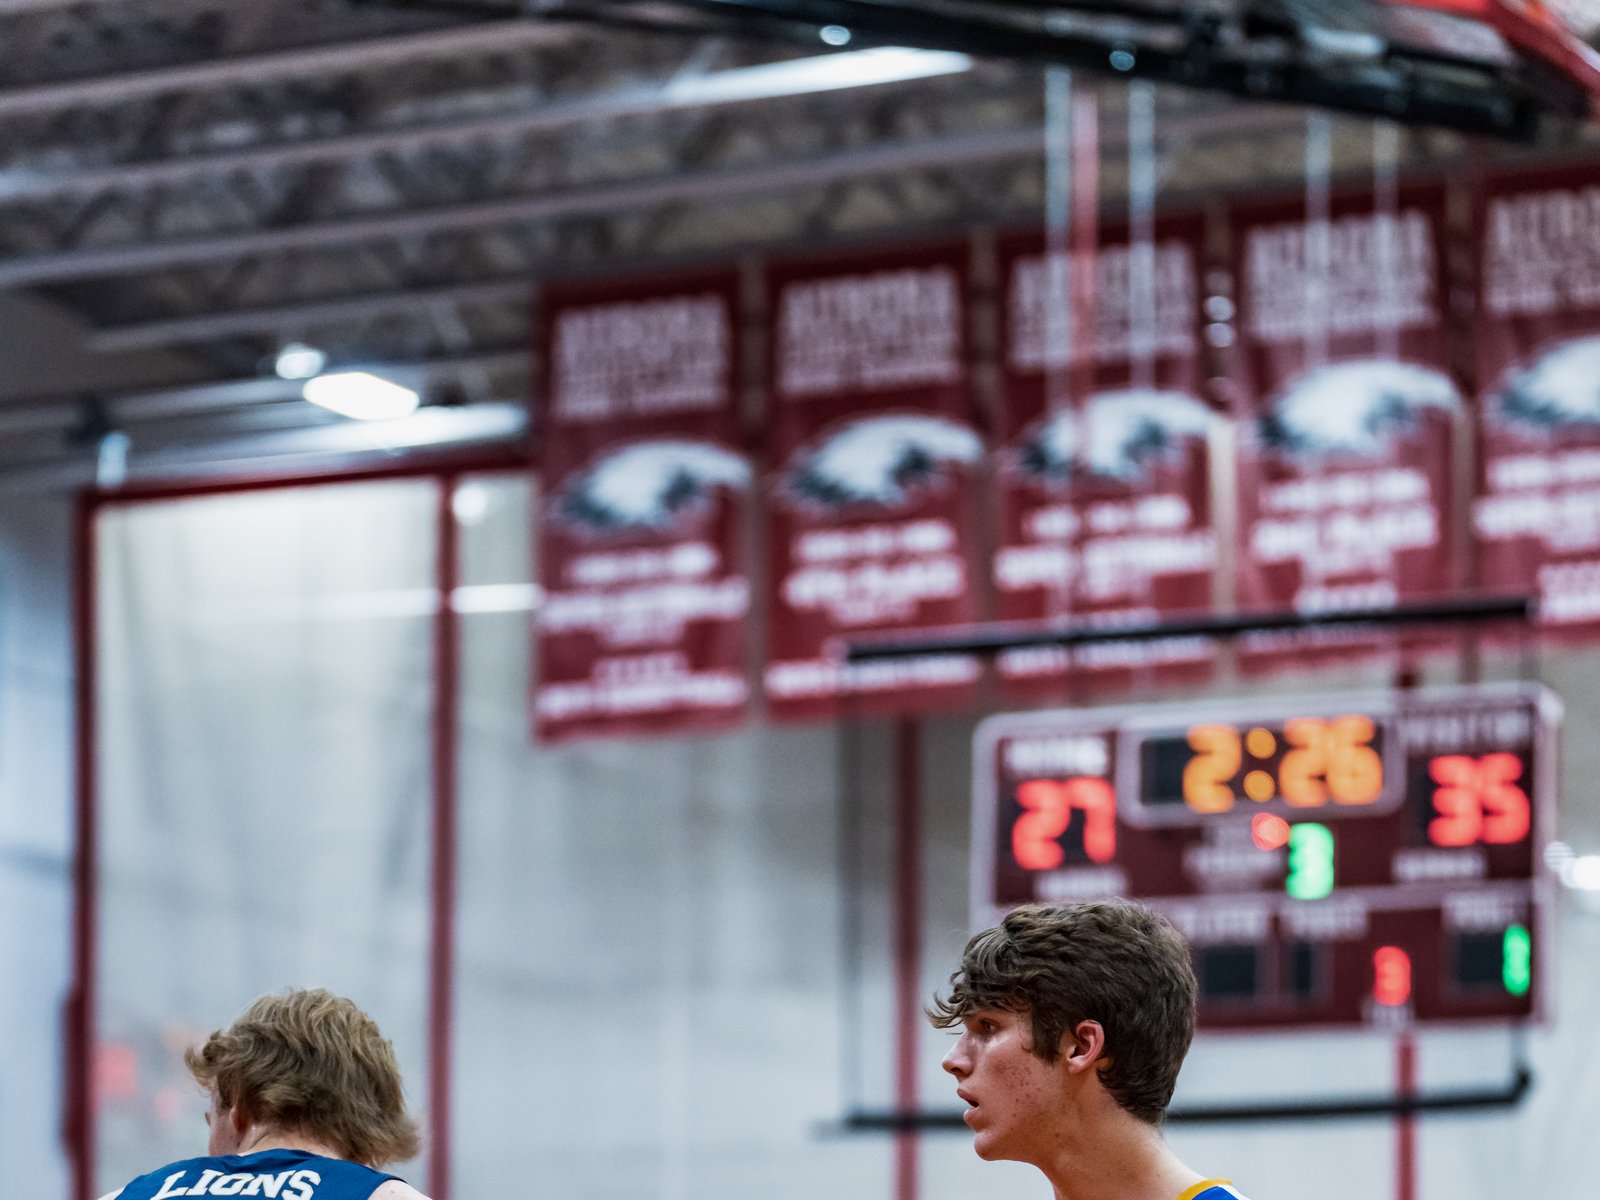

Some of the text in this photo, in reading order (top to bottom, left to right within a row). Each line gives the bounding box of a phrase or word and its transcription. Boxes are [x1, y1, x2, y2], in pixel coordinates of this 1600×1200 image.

[1183, 715, 1383, 813] 2:26
[1428, 753, 1530, 847] 35
[1012, 777, 1116, 870] 27
